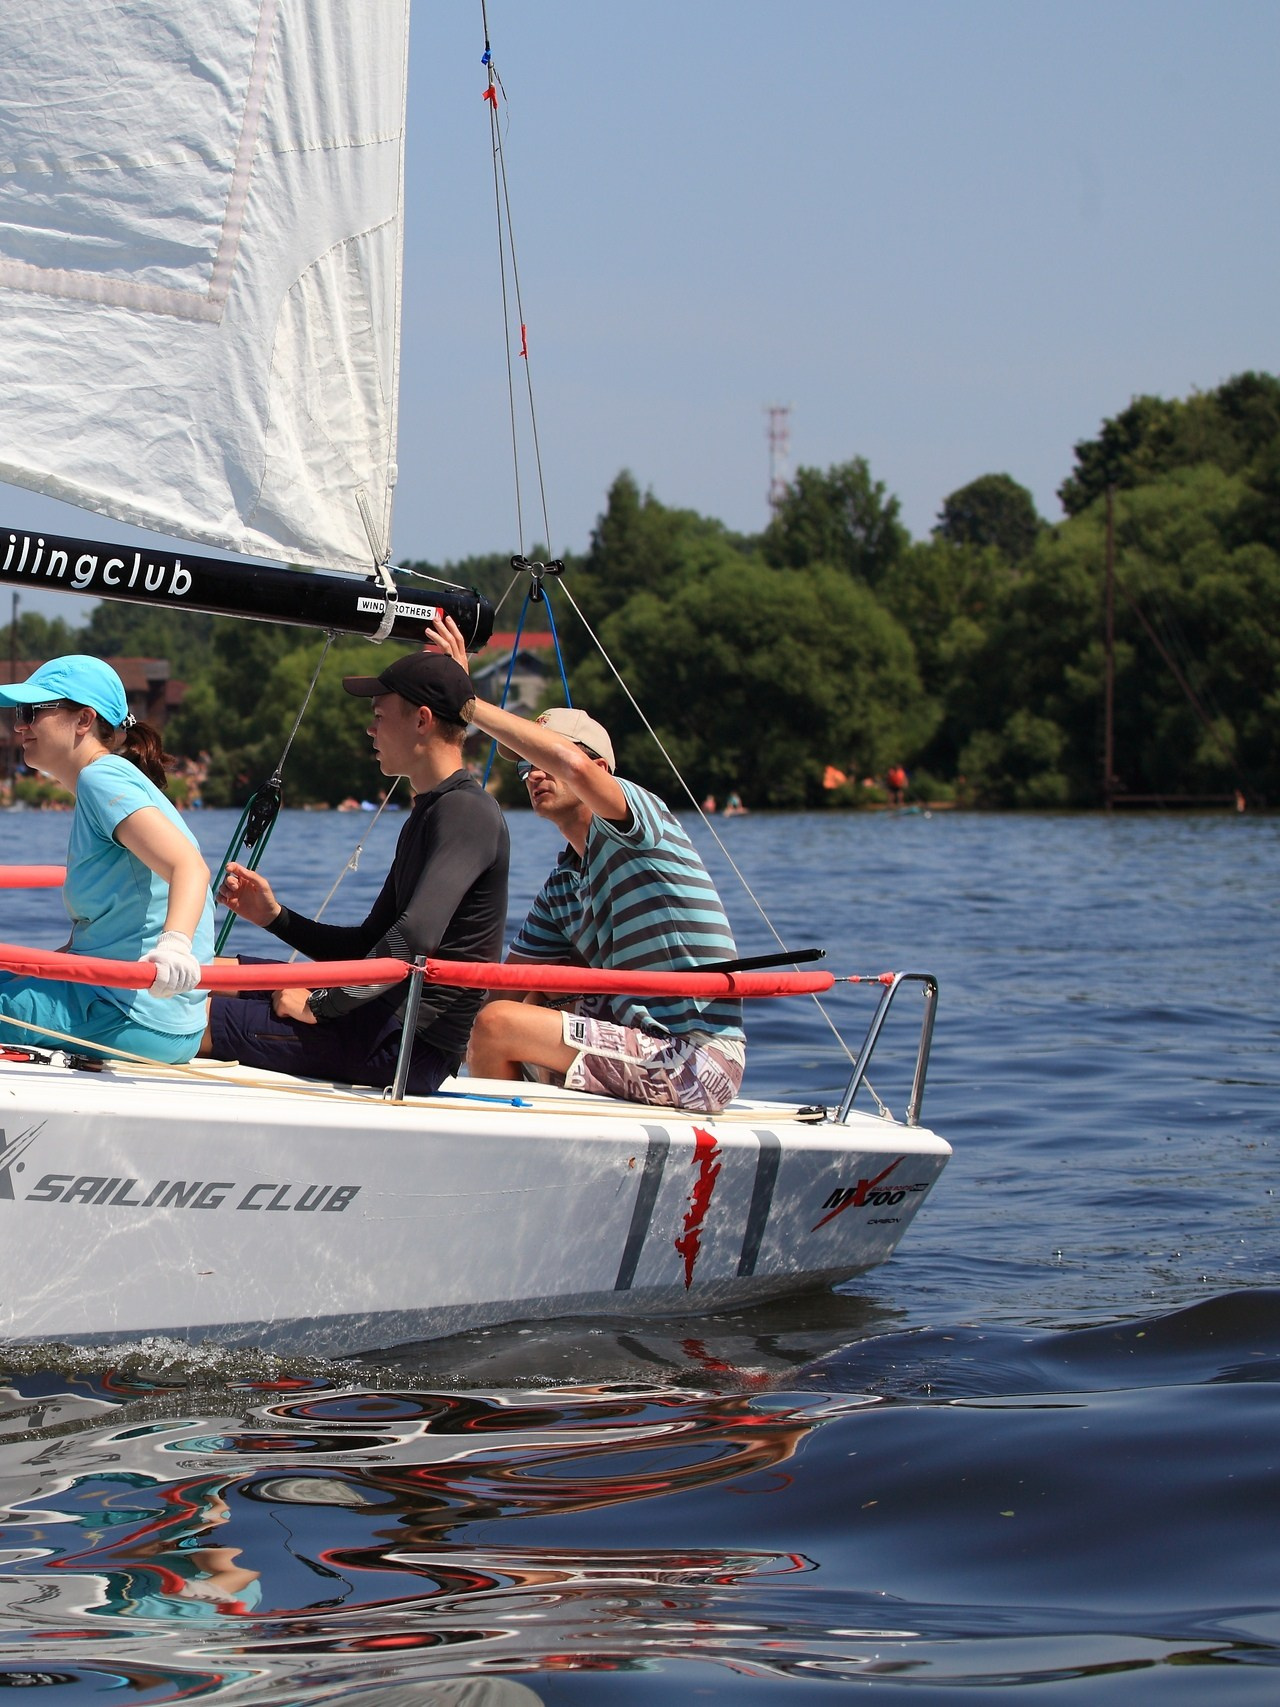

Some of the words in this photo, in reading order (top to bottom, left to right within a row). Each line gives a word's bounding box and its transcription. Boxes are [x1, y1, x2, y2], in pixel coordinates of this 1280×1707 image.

[362, 600, 385, 611] WIND
[395, 604, 432, 618] ROTHERS
[25, 1174, 236, 1210] SAILING
[235, 1183, 362, 1212] CLUB
